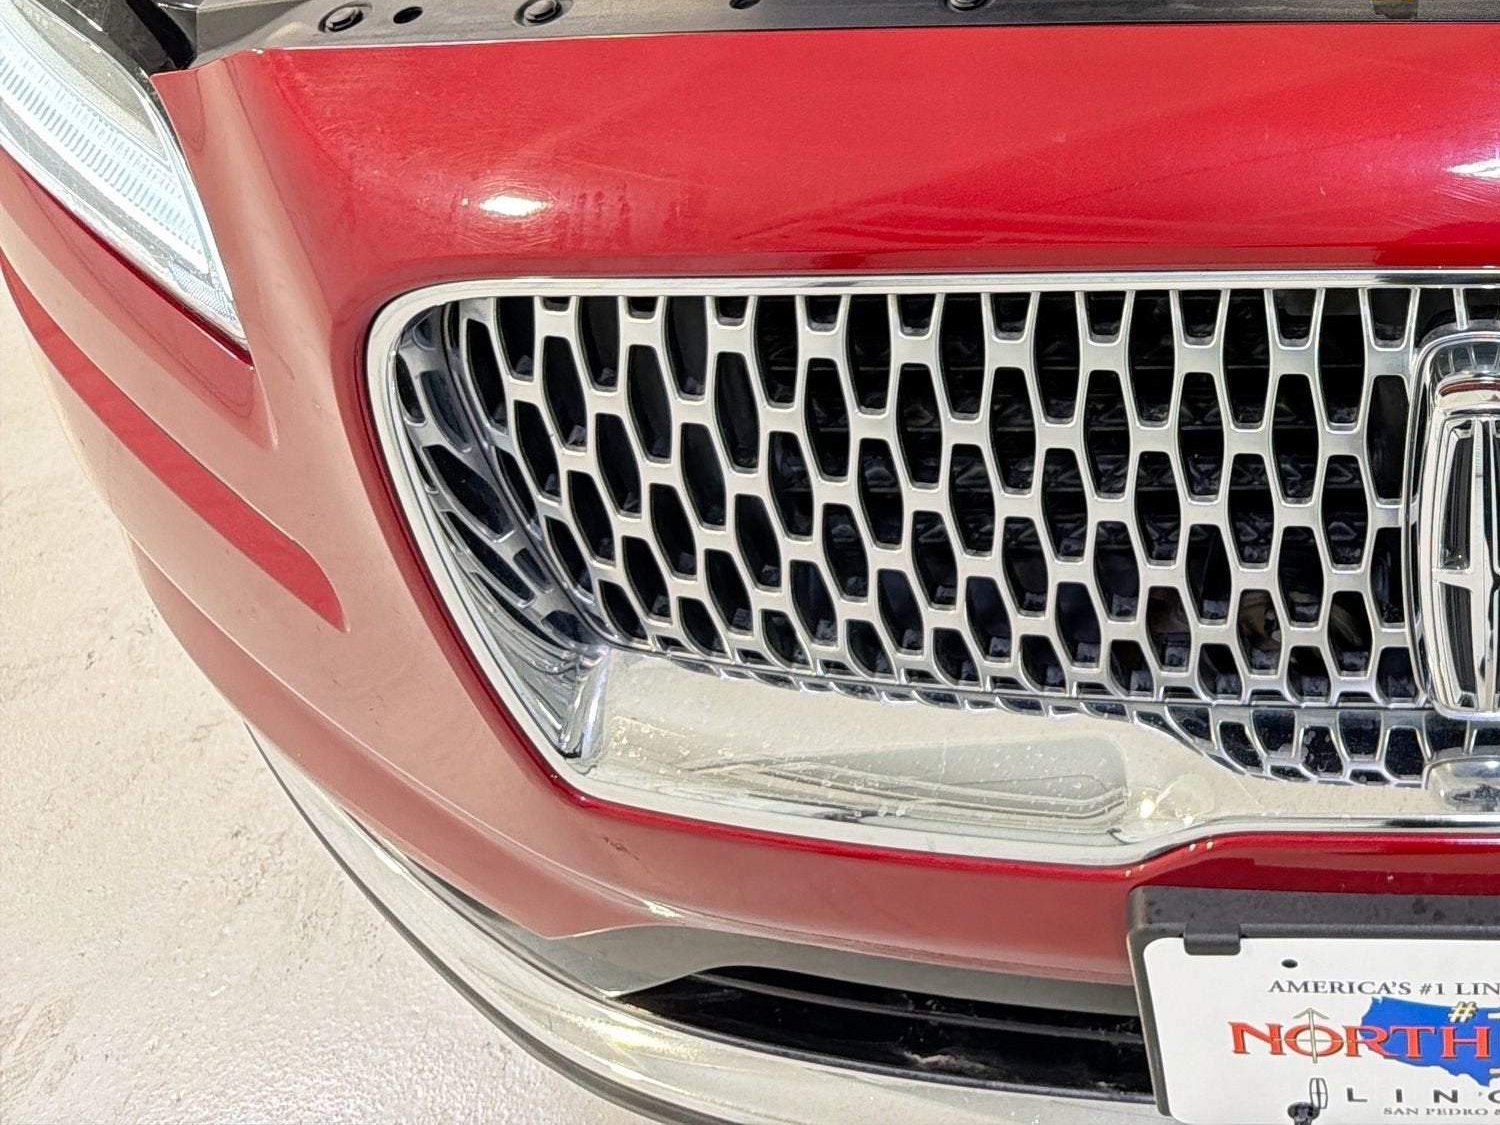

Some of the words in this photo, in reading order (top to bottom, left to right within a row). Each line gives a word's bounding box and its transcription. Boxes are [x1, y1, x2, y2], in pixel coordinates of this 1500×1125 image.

[1268, 980, 1412, 995] AMERICA'S
[1419, 982, 1446, 996] #1
[1228, 1021, 1492, 1059] NORTH
[1383, 1107, 1419, 1116] SAN
[1425, 1107, 1489, 1116] PEDRO
